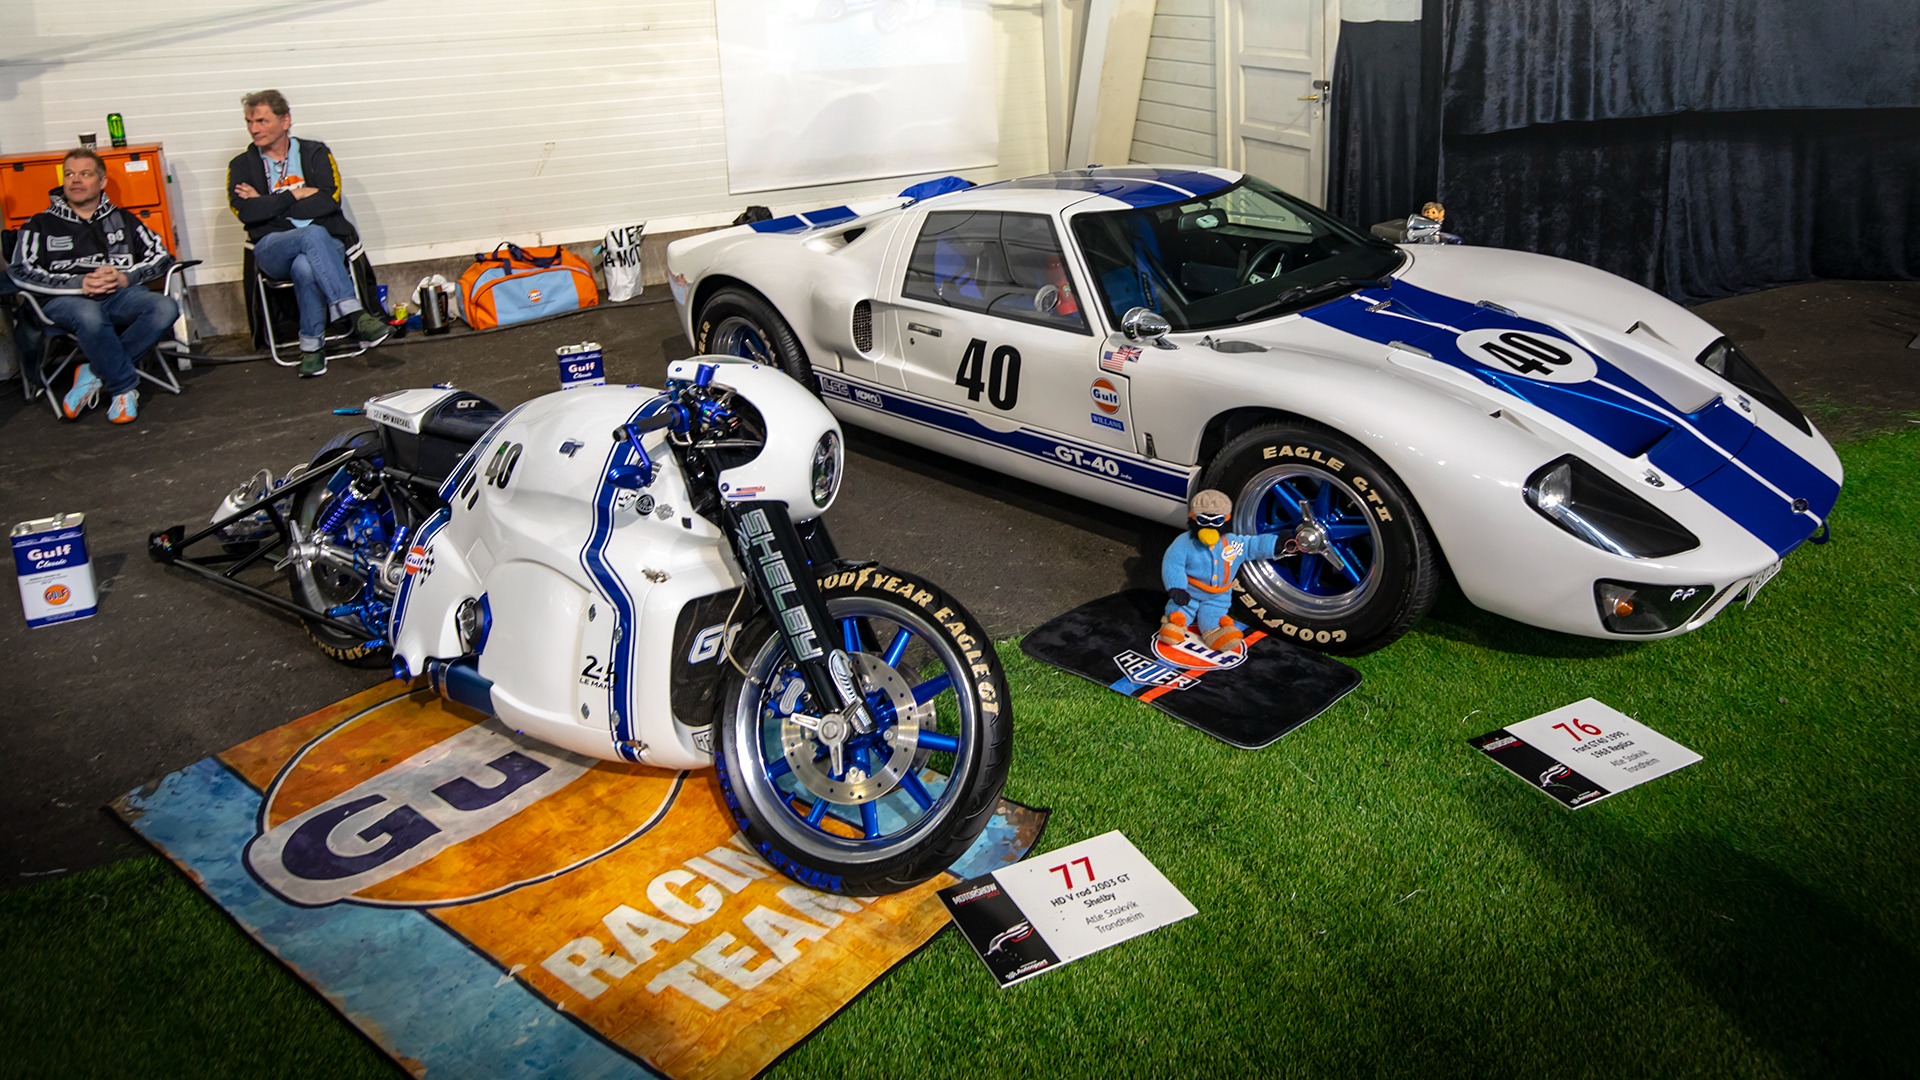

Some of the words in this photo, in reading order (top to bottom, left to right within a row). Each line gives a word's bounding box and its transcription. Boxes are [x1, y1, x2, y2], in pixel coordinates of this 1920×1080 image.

[568, 361, 596, 373] Gulf
[1479, 332, 1573, 376] 40
[955, 337, 1022, 411] 40
[456, 399, 480, 409] GT
[1093, 388, 1118, 404] Gulf
[1092, 414, 1123, 430] WILLANS
[558, 438, 585, 459] GT
[1055, 445, 1120, 477] GT-40
[1262, 445, 1346, 472] EAGLE
[485, 440, 524, 489] 40
[27, 544, 72, 561] Gulf
[35, 558, 68, 570] Classic
[406, 553, 424, 566] Gulf
[741, 508, 824, 661] SHELBY
[1231, 578, 1347, 644] GOODYEA
[688, 622, 743, 666] GT
[933, 606, 992, 679] EAGLE
[1183, 634, 1240, 665] ulf
[1119, 652, 1193, 688] HEUER
[1551, 718, 1602, 742] 76
[1572, 743, 1592, 753] Ford
[1587, 737, 1608, 748] GT40
[1606, 740, 1635, 750] Replica
[1623, 758, 1660, 774] Trondheim
[282, 751, 552, 880] Gu
[1048, 856, 1096, 890] 77
[1050, 896, 1067, 907] HD
[1066, 893, 1074, 901] V
[1075, 887, 1091, 899] rod
[1091, 878, 1117, 893] 2003
[1116, 873, 1131, 884] GT
[1083, 892, 1116, 908] Shelby
[541, 834, 772, 1000] RACIN
[1085, 913, 1105, 926] Atle
[1103, 901, 1139, 918] Stokvik
[1094, 911, 1145, 934] Trondheim
